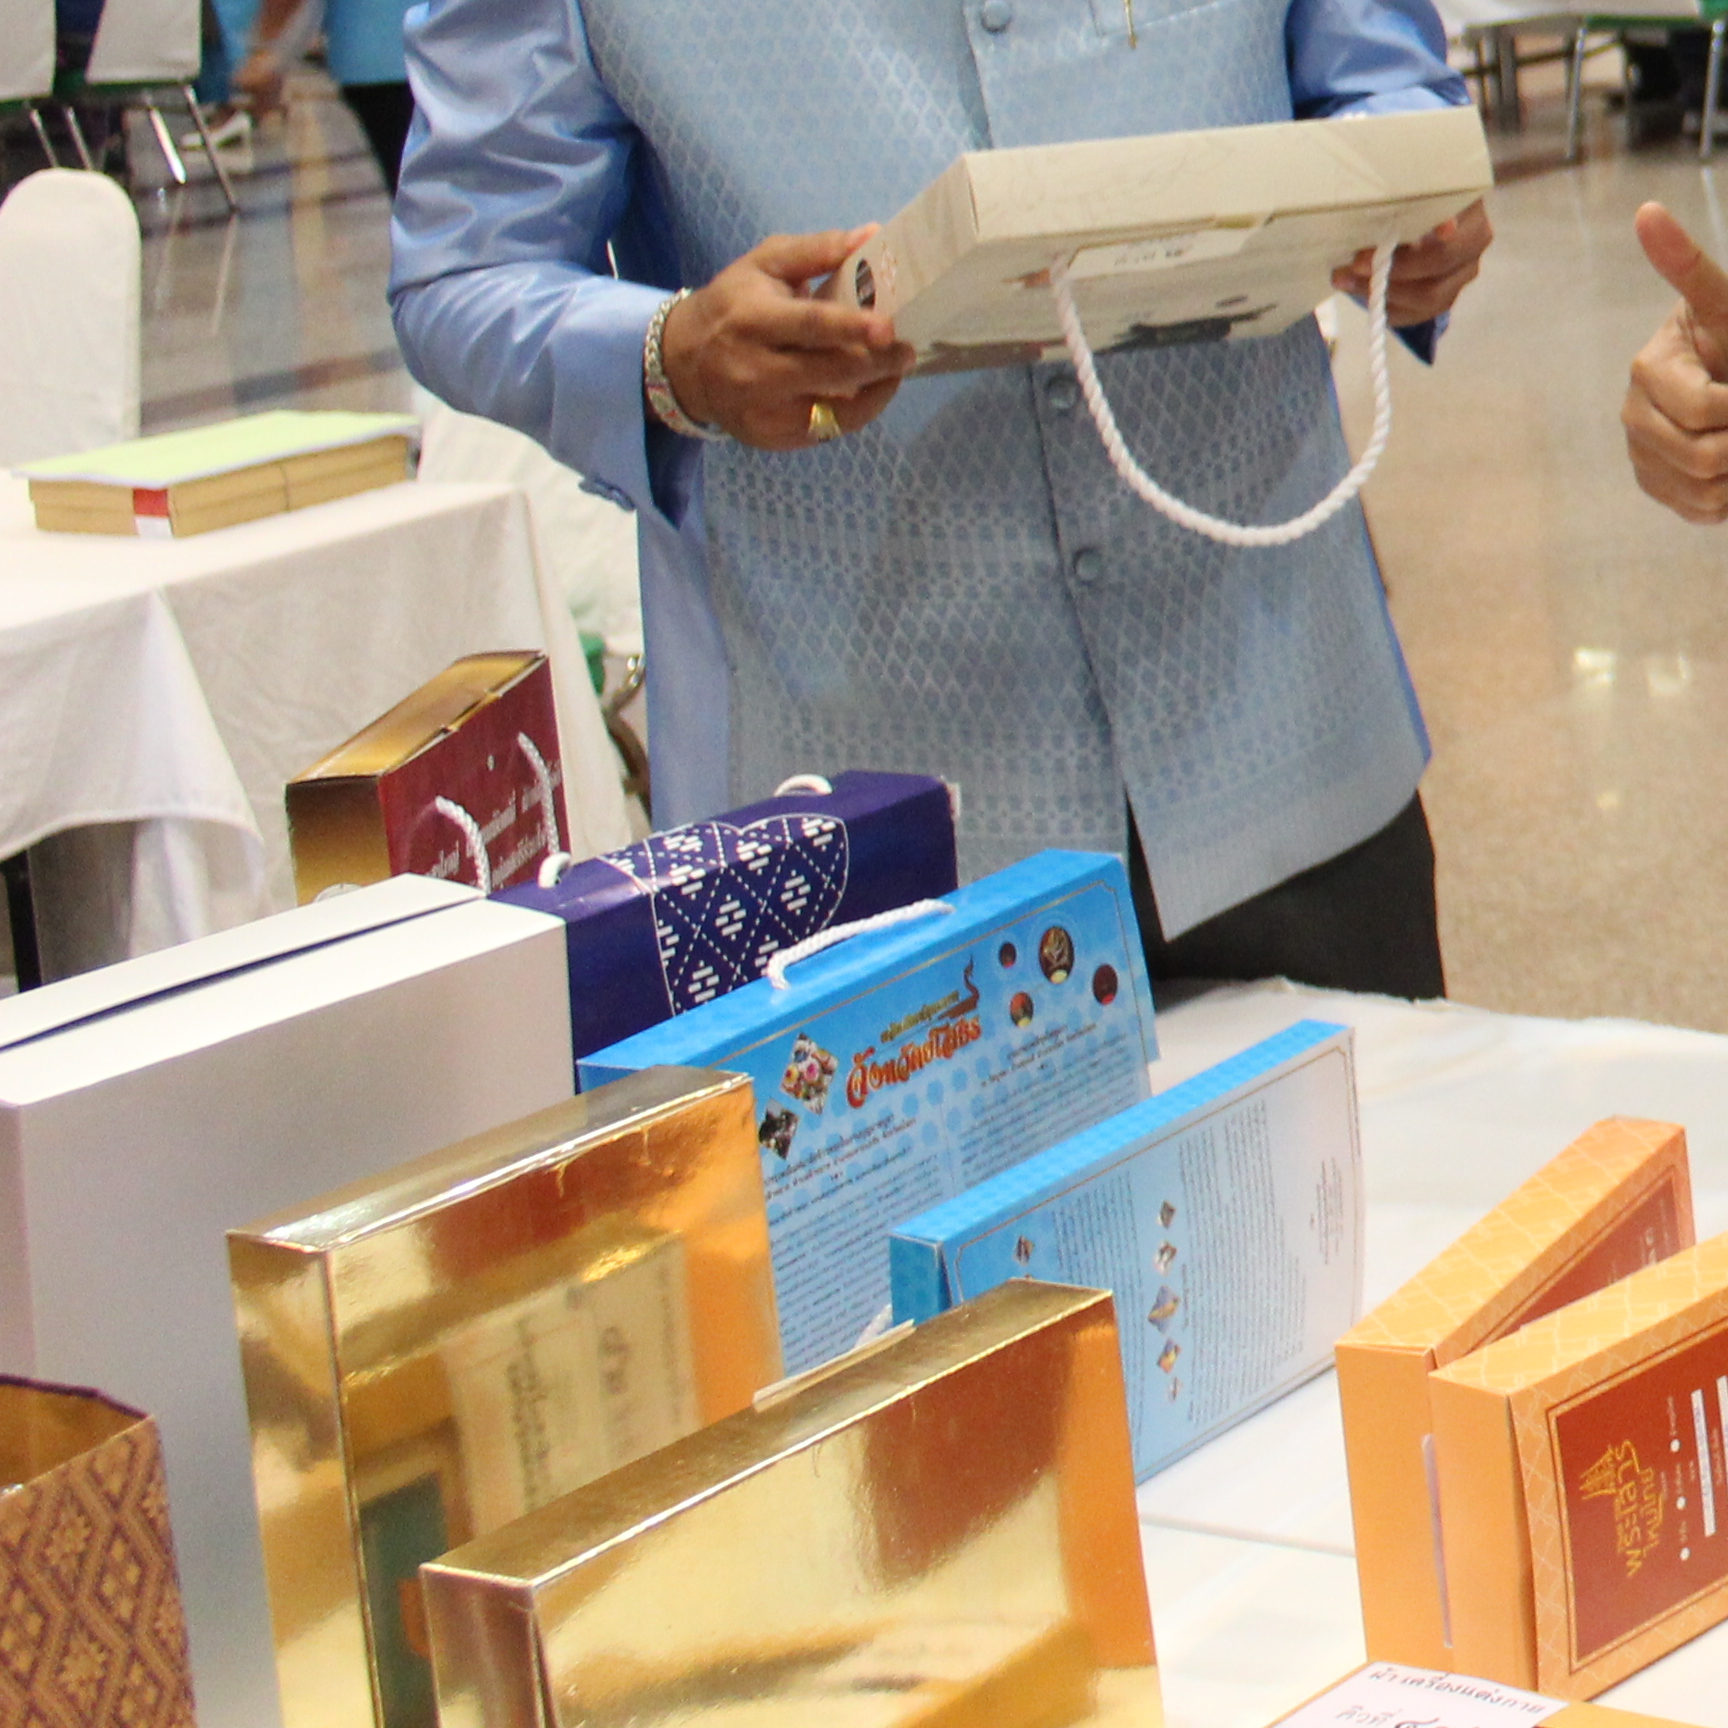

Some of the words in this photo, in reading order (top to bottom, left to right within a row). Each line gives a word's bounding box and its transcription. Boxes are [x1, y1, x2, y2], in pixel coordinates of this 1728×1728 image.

[1369, 1666, 1398, 1683] ผ้า
[1400, 1672, 1547, 1714] เครื่องแต่งกาย
